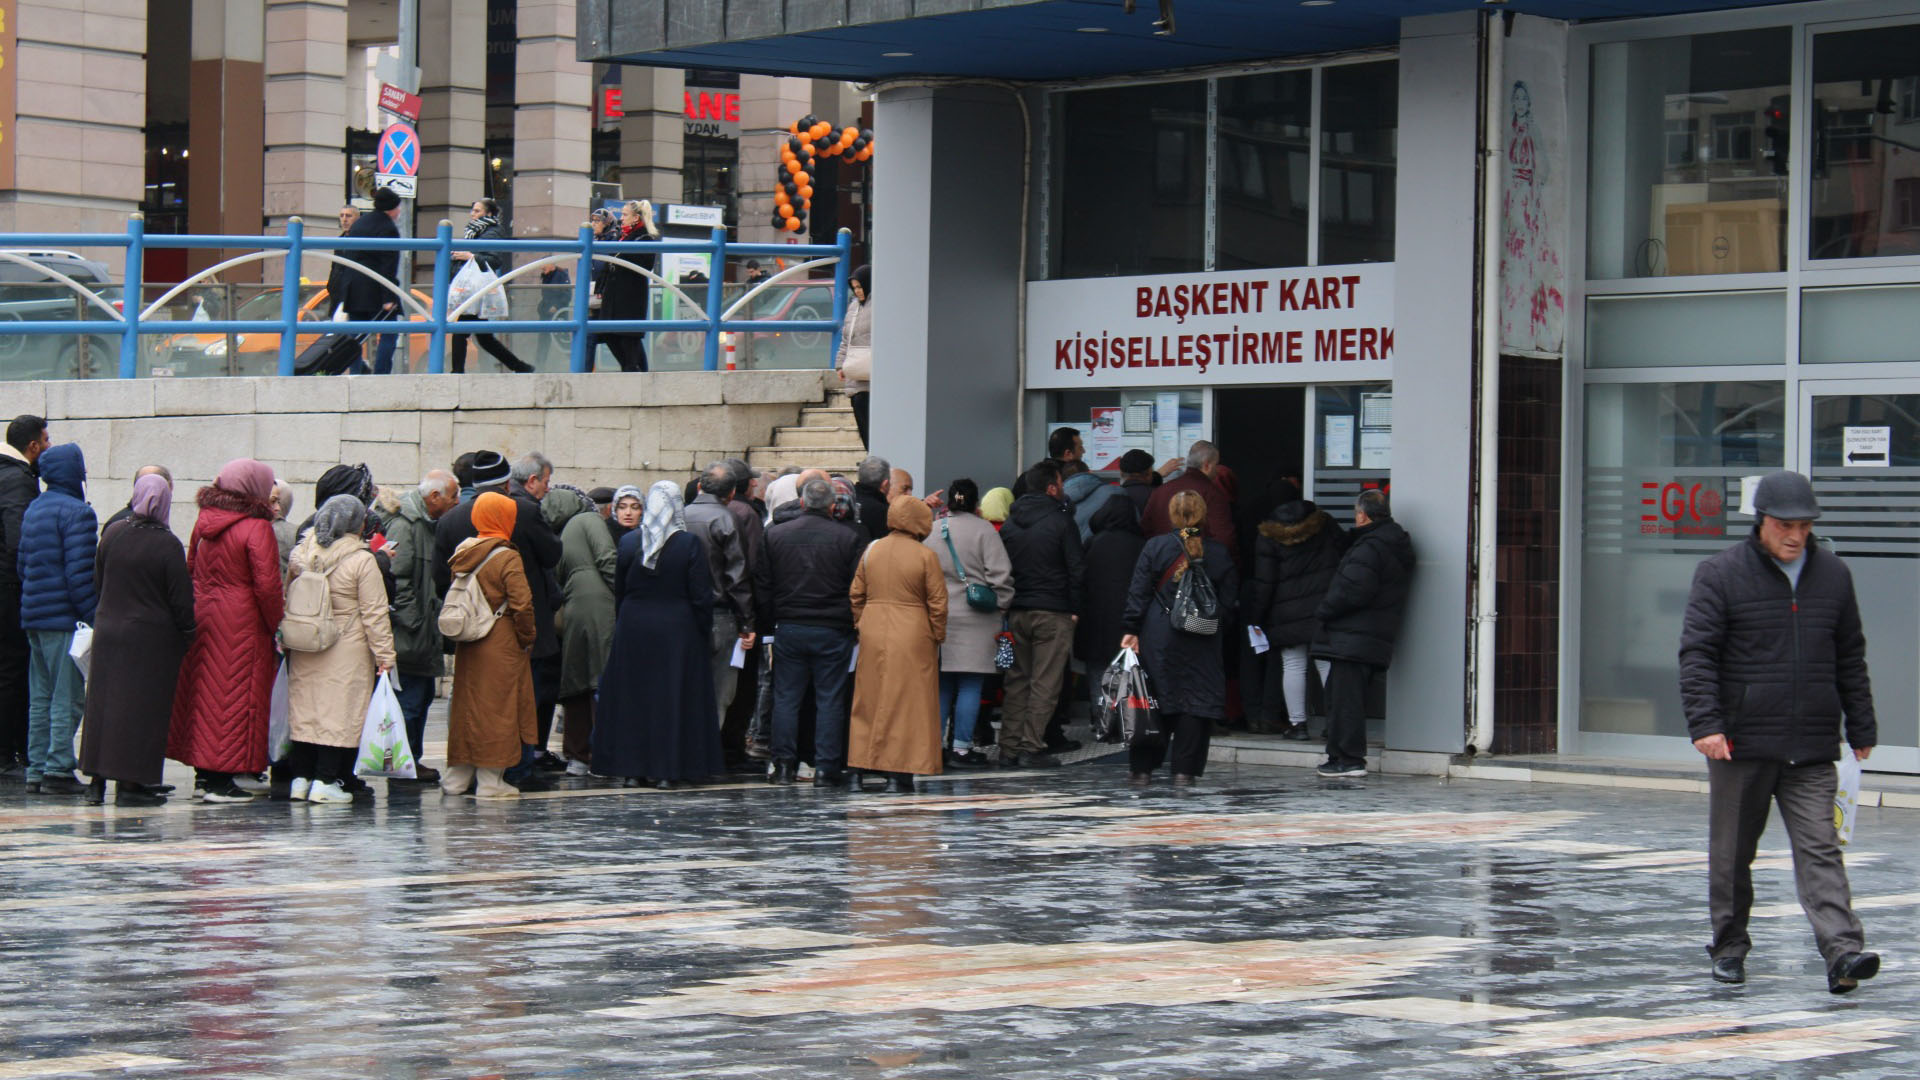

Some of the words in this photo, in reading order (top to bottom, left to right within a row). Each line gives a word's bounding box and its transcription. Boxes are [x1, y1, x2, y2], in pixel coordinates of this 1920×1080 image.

[684, 122, 720, 135] YDAN
[1136, 281, 1269, 324] BAŞKENT
[1279, 275, 1361, 312] KART
[1055, 325, 1303, 377] KİŞİSELLEŞTİRME
